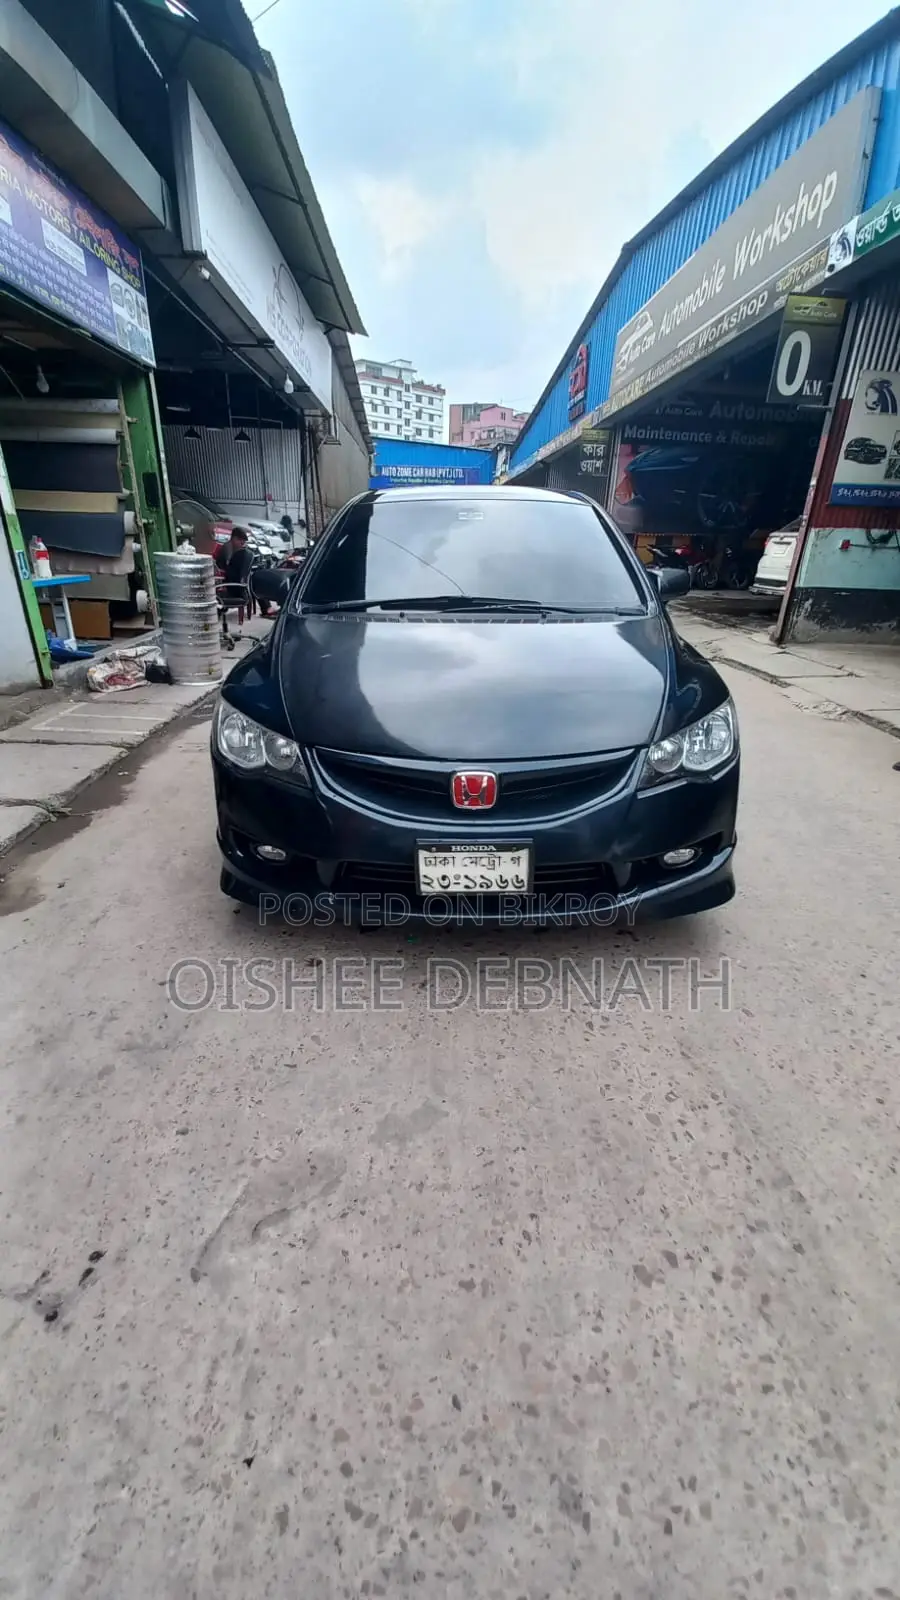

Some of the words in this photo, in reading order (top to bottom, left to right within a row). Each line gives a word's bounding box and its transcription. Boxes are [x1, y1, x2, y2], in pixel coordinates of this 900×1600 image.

[24, 187, 70, 233] MOTORS
[73, 225, 121, 274] TAILORING
[658, 258, 727, 341] Automobile
[733, 169, 838, 281] Workshop
[645, 342, 696, 384] Automobile
[698, 289, 768, 348] Workshop
[777, 329, 812, 397] 0
[624, 424, 712, 444] Maintenance
[716, 431, 728, 445] &
[583, 443, 607, 457] কার
[382, 466, 397, 477] AUTO
[451, 844, 497, 852] HONDA
[423, 855, 456, 868] ঢাকা
[422, 873, 526, 890] ২৩-১৯৬৬
